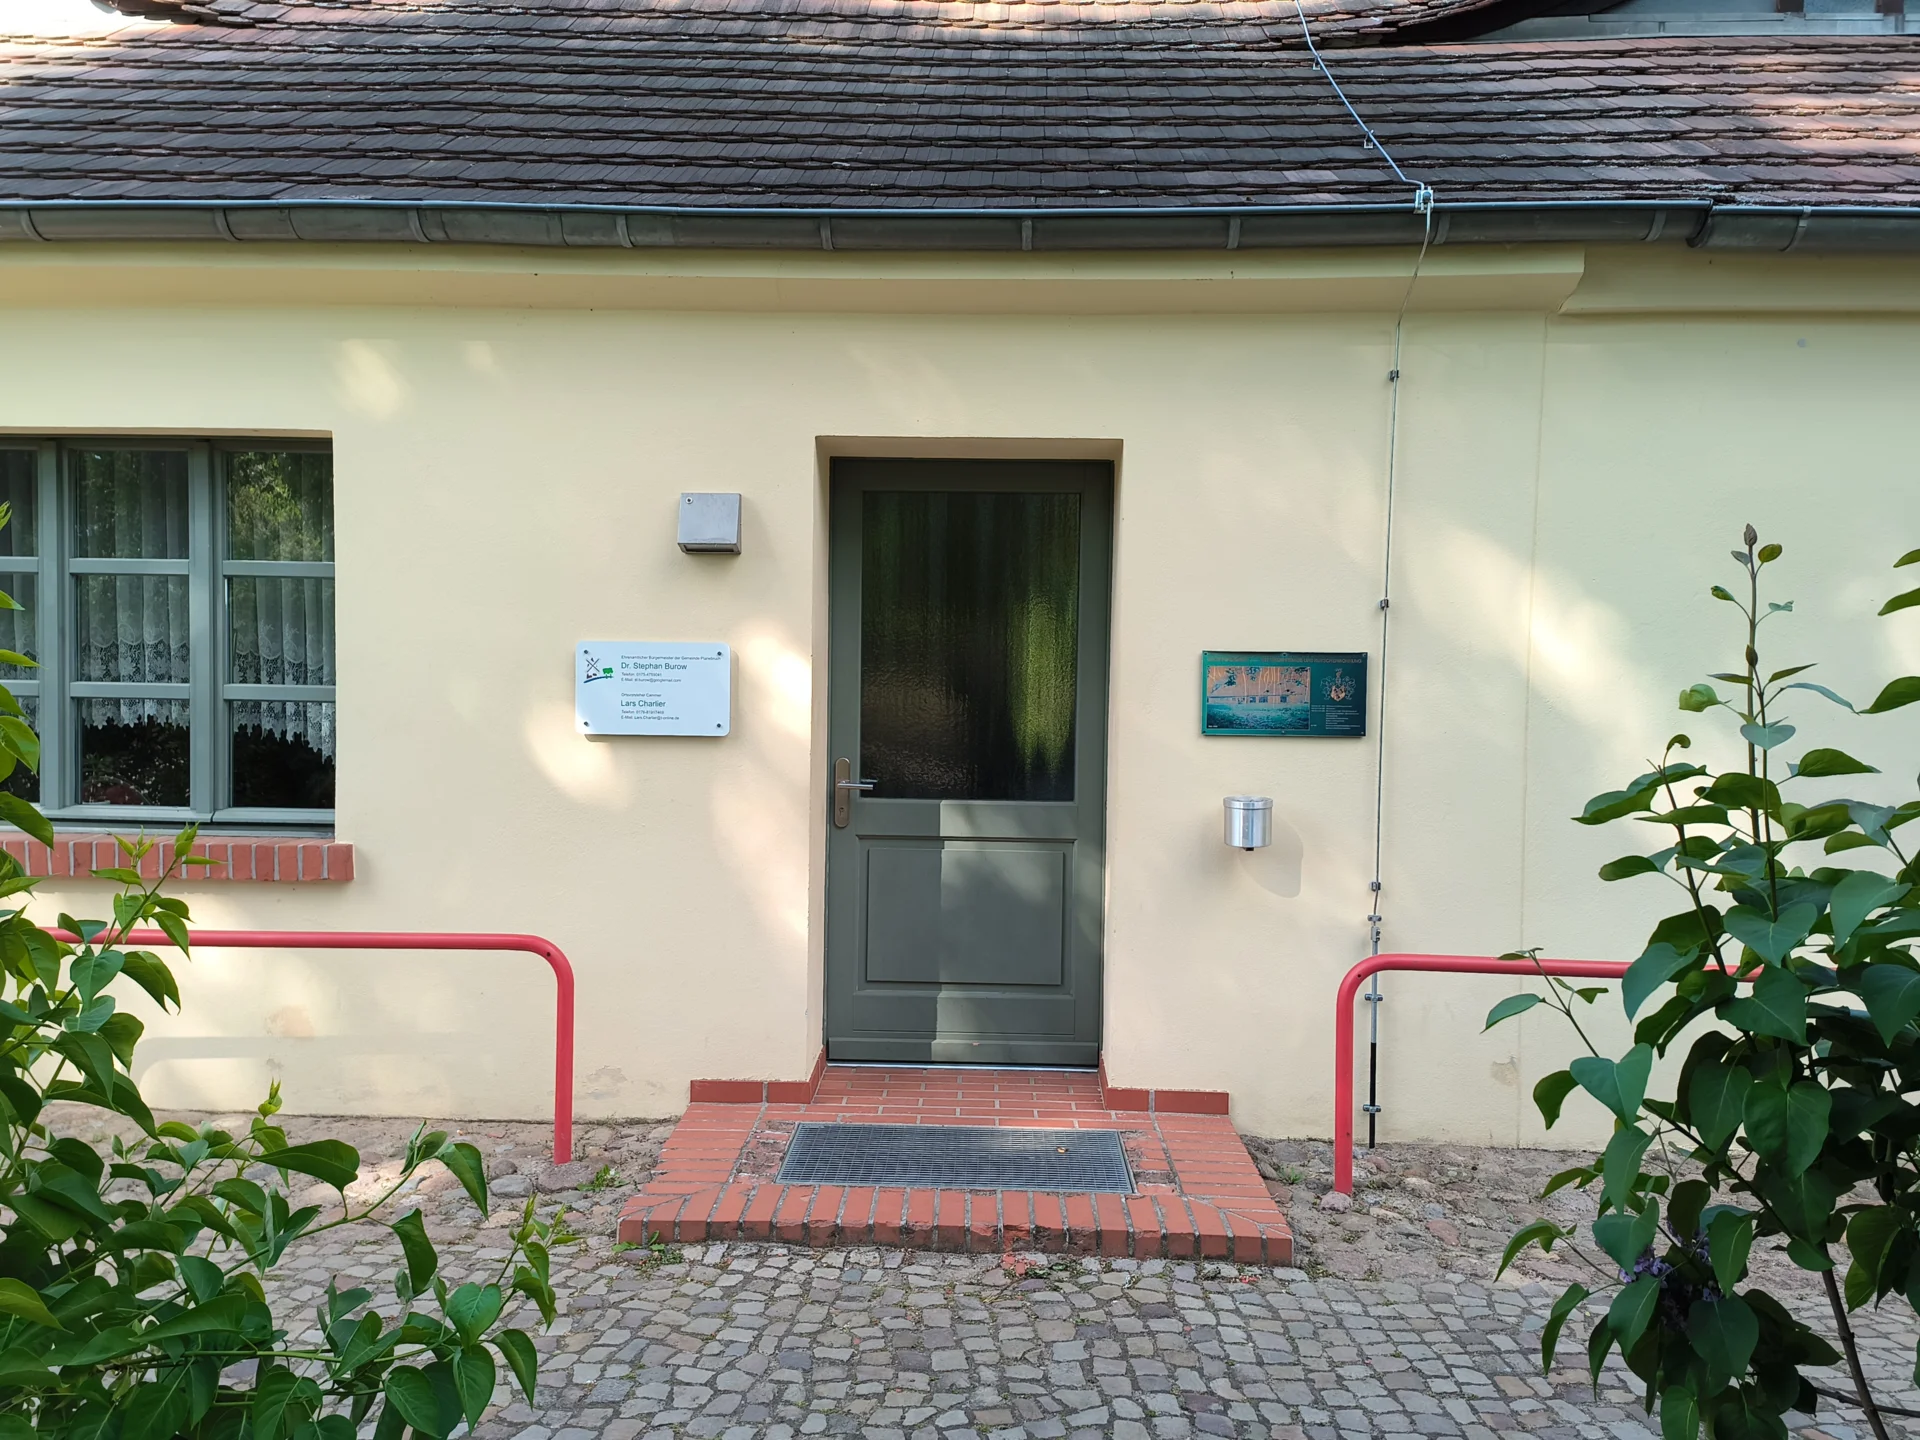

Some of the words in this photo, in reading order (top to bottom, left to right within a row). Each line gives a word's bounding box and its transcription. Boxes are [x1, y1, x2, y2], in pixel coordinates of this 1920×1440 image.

[633, 662, 663, 671] Stephan
[664, 662, 688, 670] Burow
[621, 699, 636, 707] Lars
[638, 699, 666, 707] Charlier
